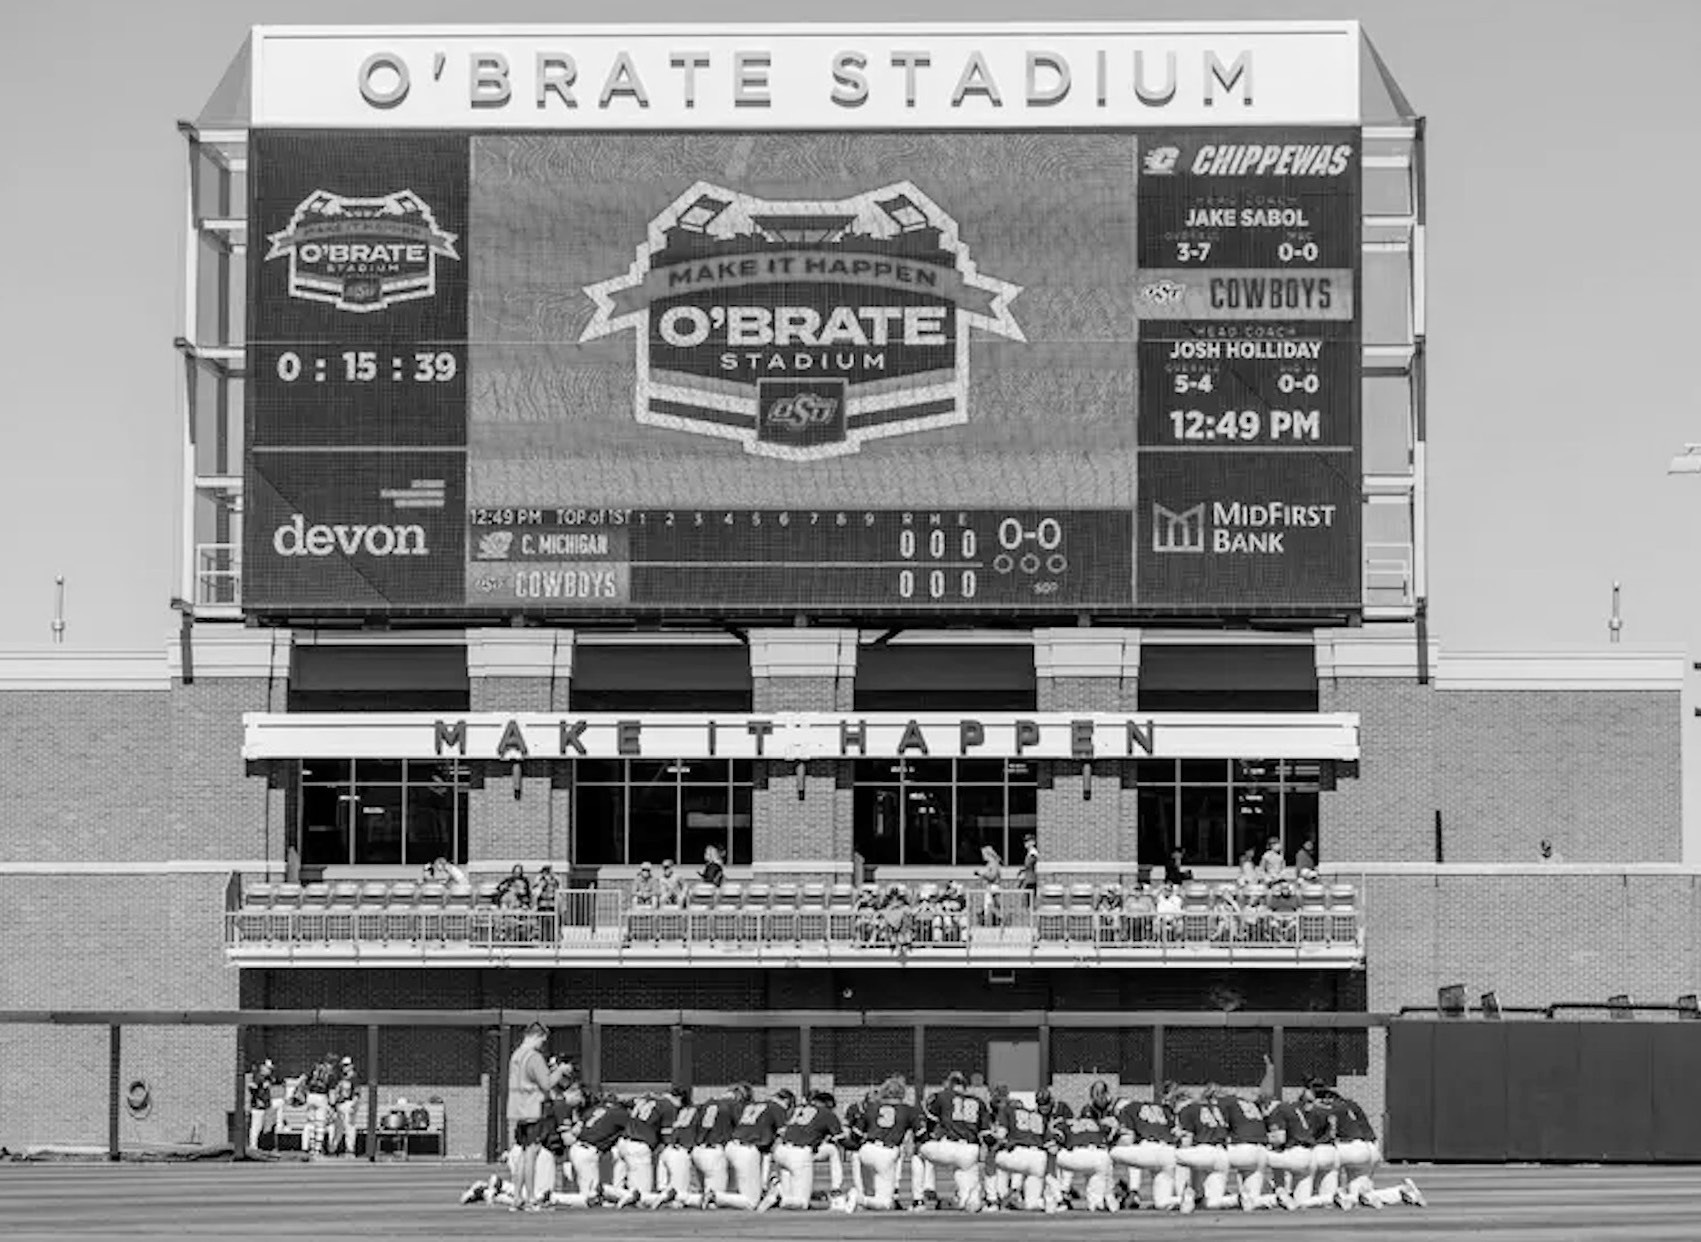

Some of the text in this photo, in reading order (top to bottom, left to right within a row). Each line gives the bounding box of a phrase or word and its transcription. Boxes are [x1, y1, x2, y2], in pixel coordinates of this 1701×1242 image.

[358, 49, 1255, 110] O'BRATE STADIUM
[1191, 144, 1352, 176] CHIPPEWAS
[1185, 208, 1309, 227] JAKE SABOL
[301, 244, 427, 263] O'BRATE
[1177, 242, 1211, 262] 3-7
[1278, 242, 1319, 262] 0-0
[668, 256, 938, 288] MAKE IT HAPPEN
[1210, 277, 1333, 310] COWBOYS
[659, 304, 948, 348] O'BRATE
[720, 352, 886, 371] STADIUM
[1169, 340, 1323, 359] JOSH HOLLIDAY
[1174, 374, 1214, 393] 5-4
[1277, 374, 1319, 393] 0-0
[1169, 410, 1321, 440] 12:49 PM
[470, 508, 542, 525] 12:49 PM
[556, 508, 586, 525] TOP
[273, 513, 430, 556] devon
[522, 534, 609, 554] C. MICHIGAN
[900, 529, 976, 558] 0 0 0
[999, 517, 1061, 550] 0-0
[515, 571, 616, 597] COWBOYS
[899, 570, 976, 598] 0 0 0
[434, 719, 1154, 757] MAKE IT HAPPEN
